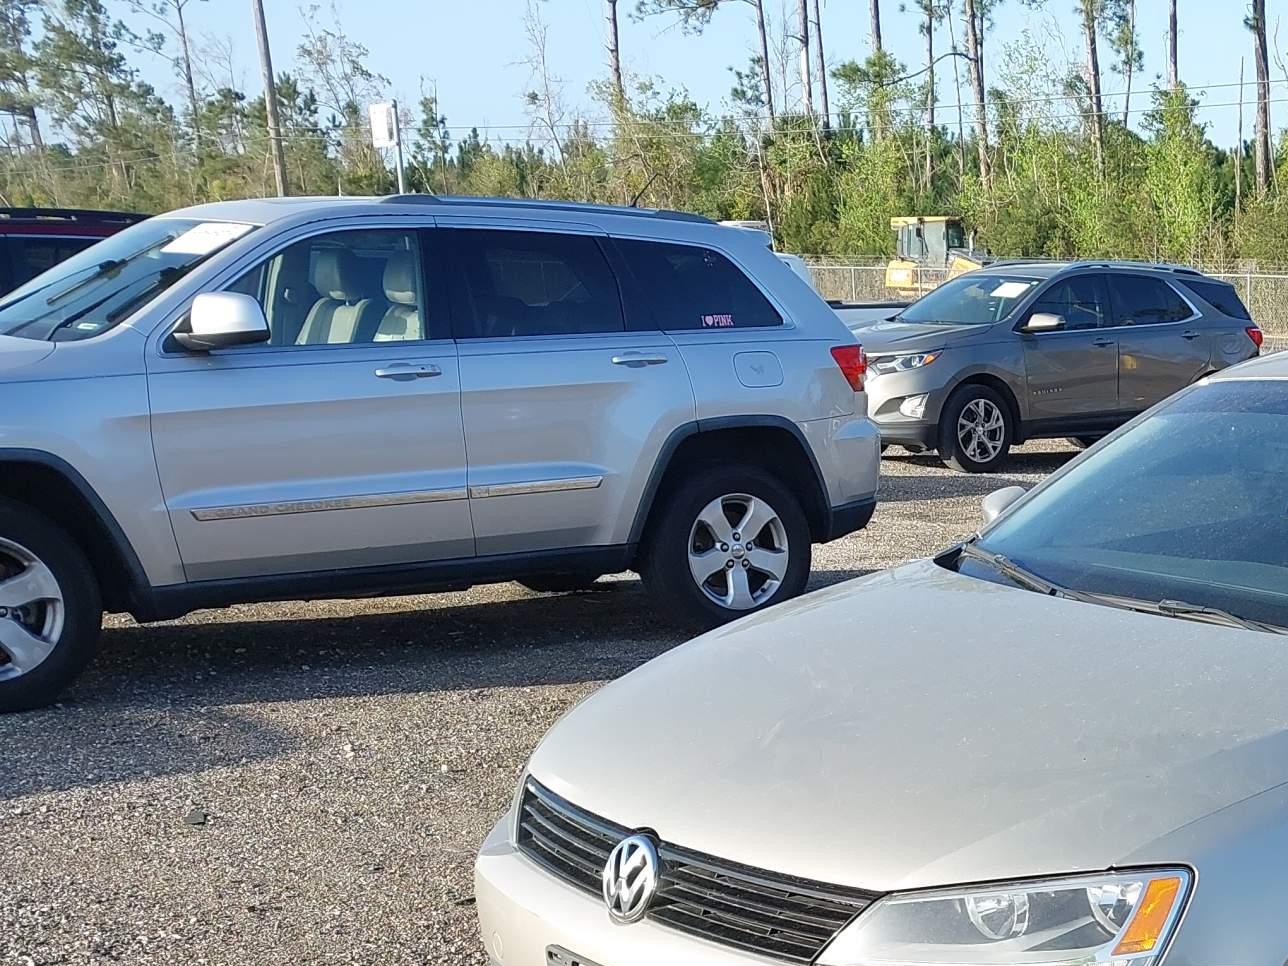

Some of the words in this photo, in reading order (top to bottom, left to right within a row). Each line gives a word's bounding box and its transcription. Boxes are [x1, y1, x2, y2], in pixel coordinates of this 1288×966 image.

[713, 314, 734, 327] PINK
[216, 505, 269, 518] GRAND
[275, 498, 352, 512] CHEROKEE
[603, 835, 657, 921] VW
